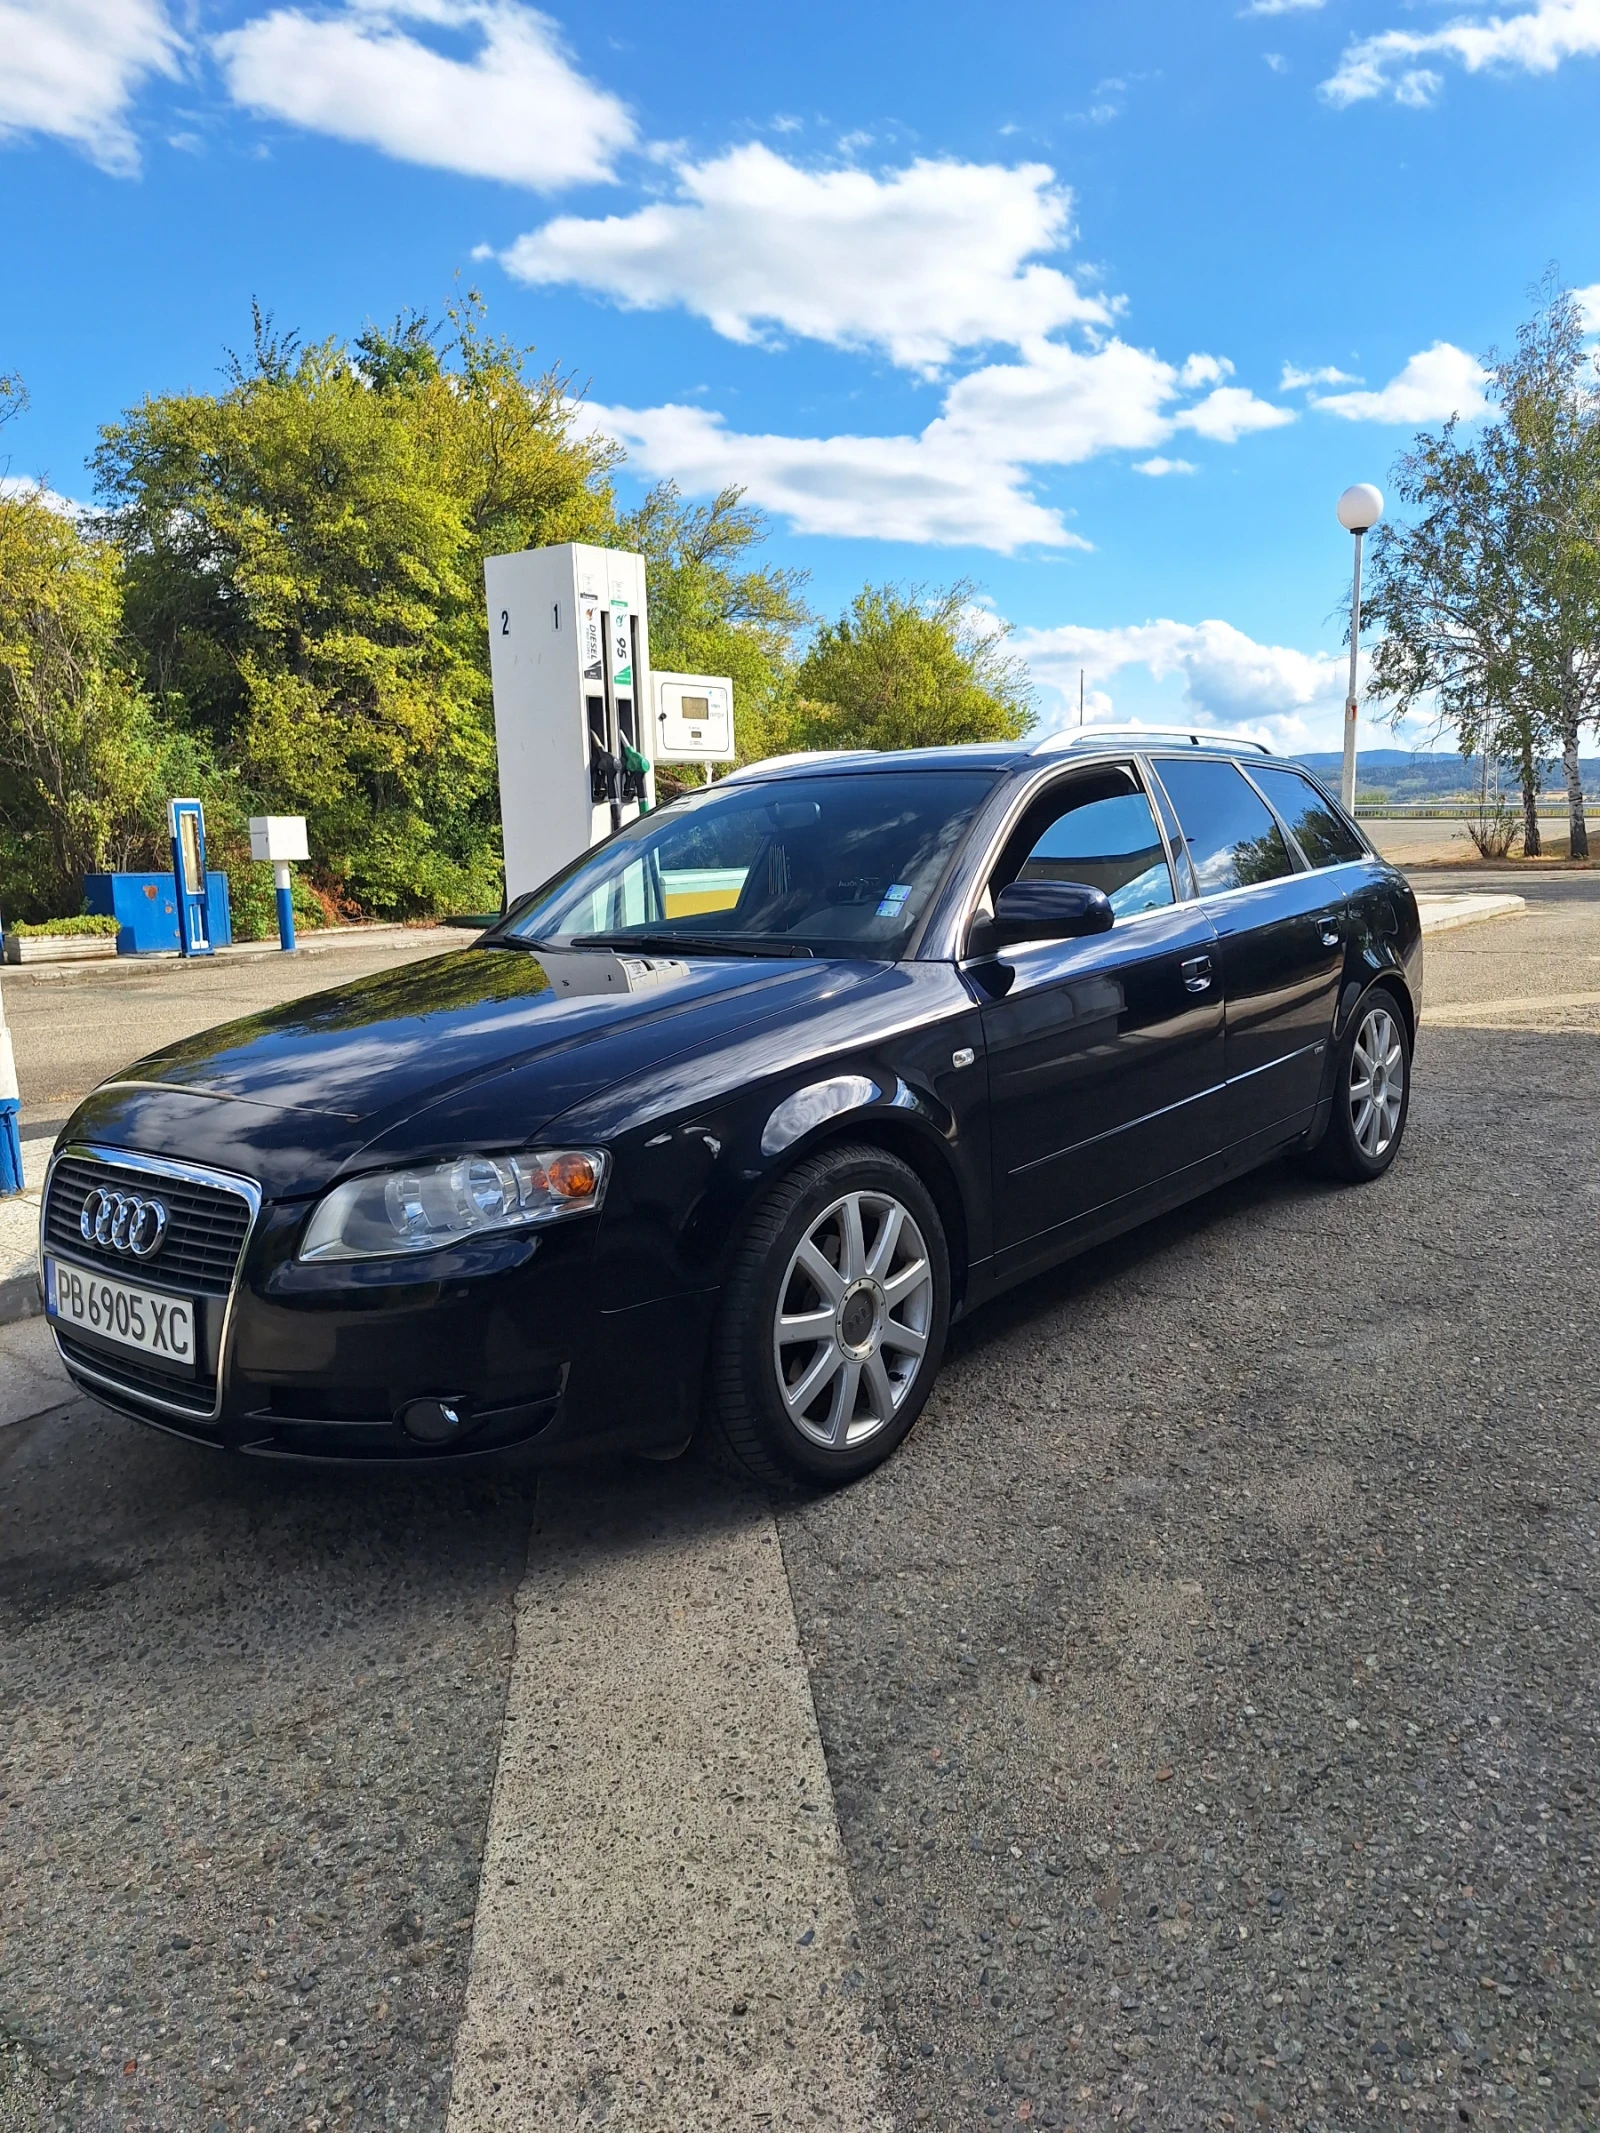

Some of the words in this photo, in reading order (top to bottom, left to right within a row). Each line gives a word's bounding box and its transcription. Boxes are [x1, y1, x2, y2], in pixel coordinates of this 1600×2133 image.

[501, 610, 509, 635] 2
[554, 603, 559, 630] 1
[589, 624, 598, 660] DIESEL
[616, 637, 627, 659] 95
